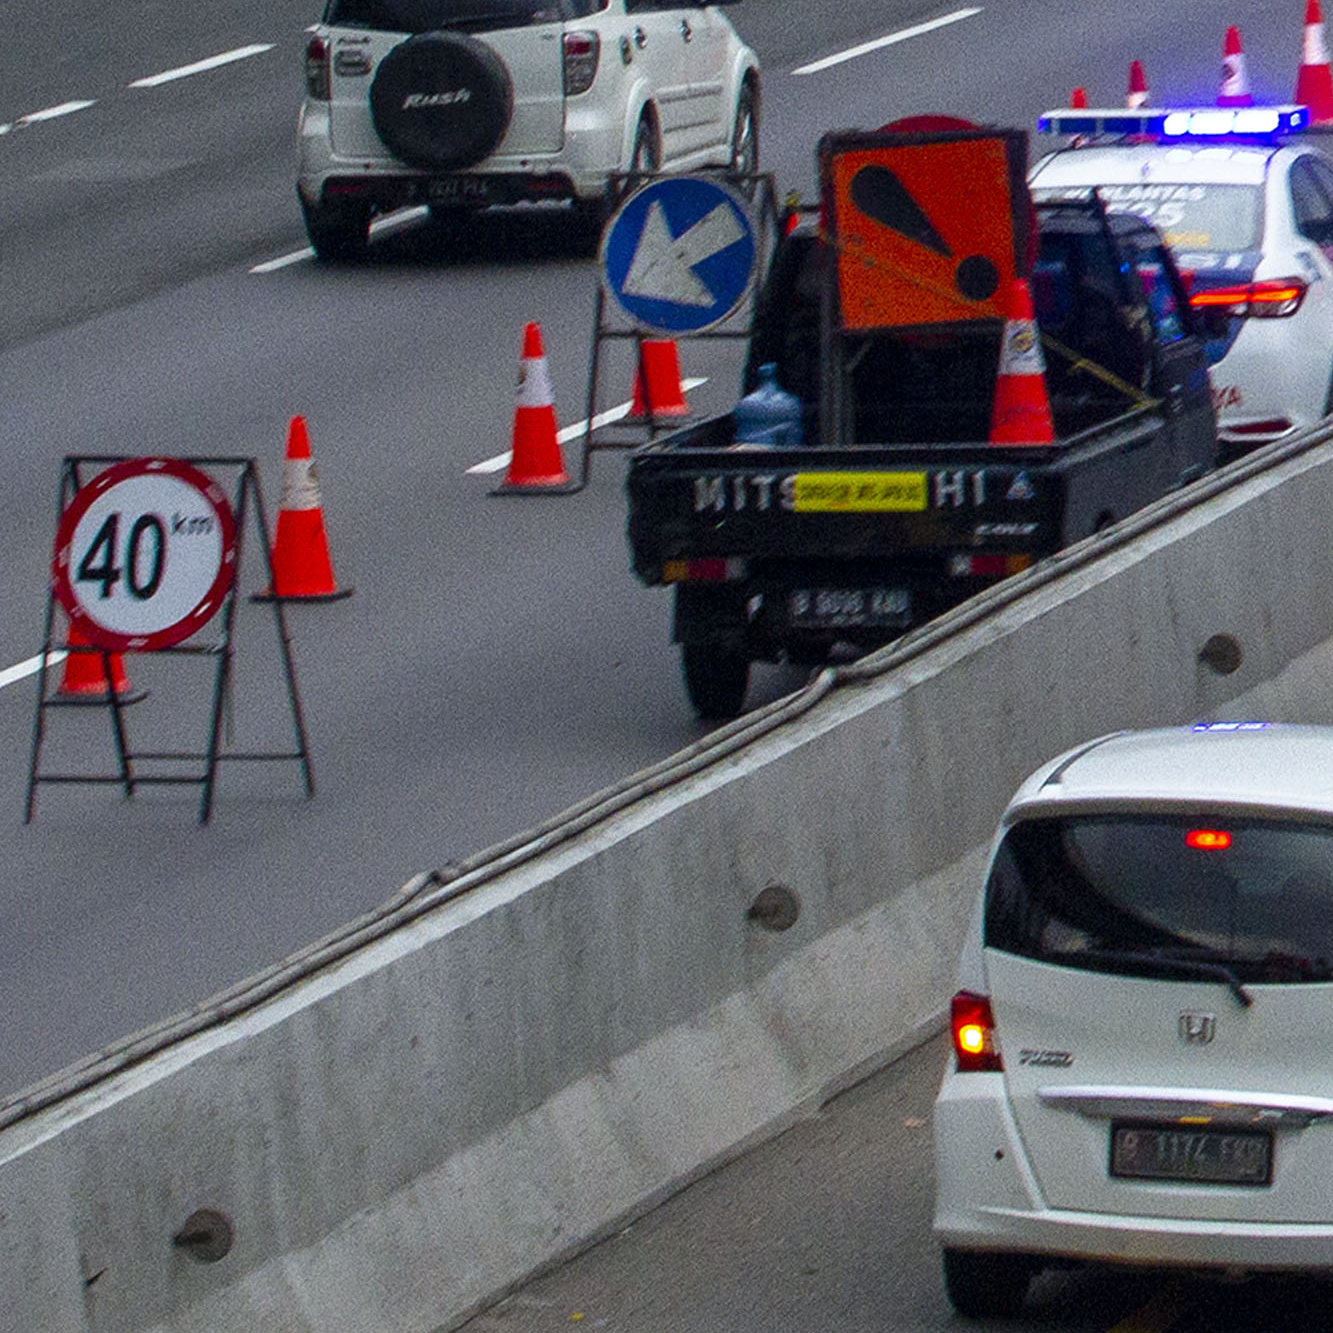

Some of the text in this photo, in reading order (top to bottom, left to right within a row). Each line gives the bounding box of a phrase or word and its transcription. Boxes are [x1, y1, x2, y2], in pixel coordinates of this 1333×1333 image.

[401, 87, 471, 109] Rush
[76, 512, 214, 601] 40 km
